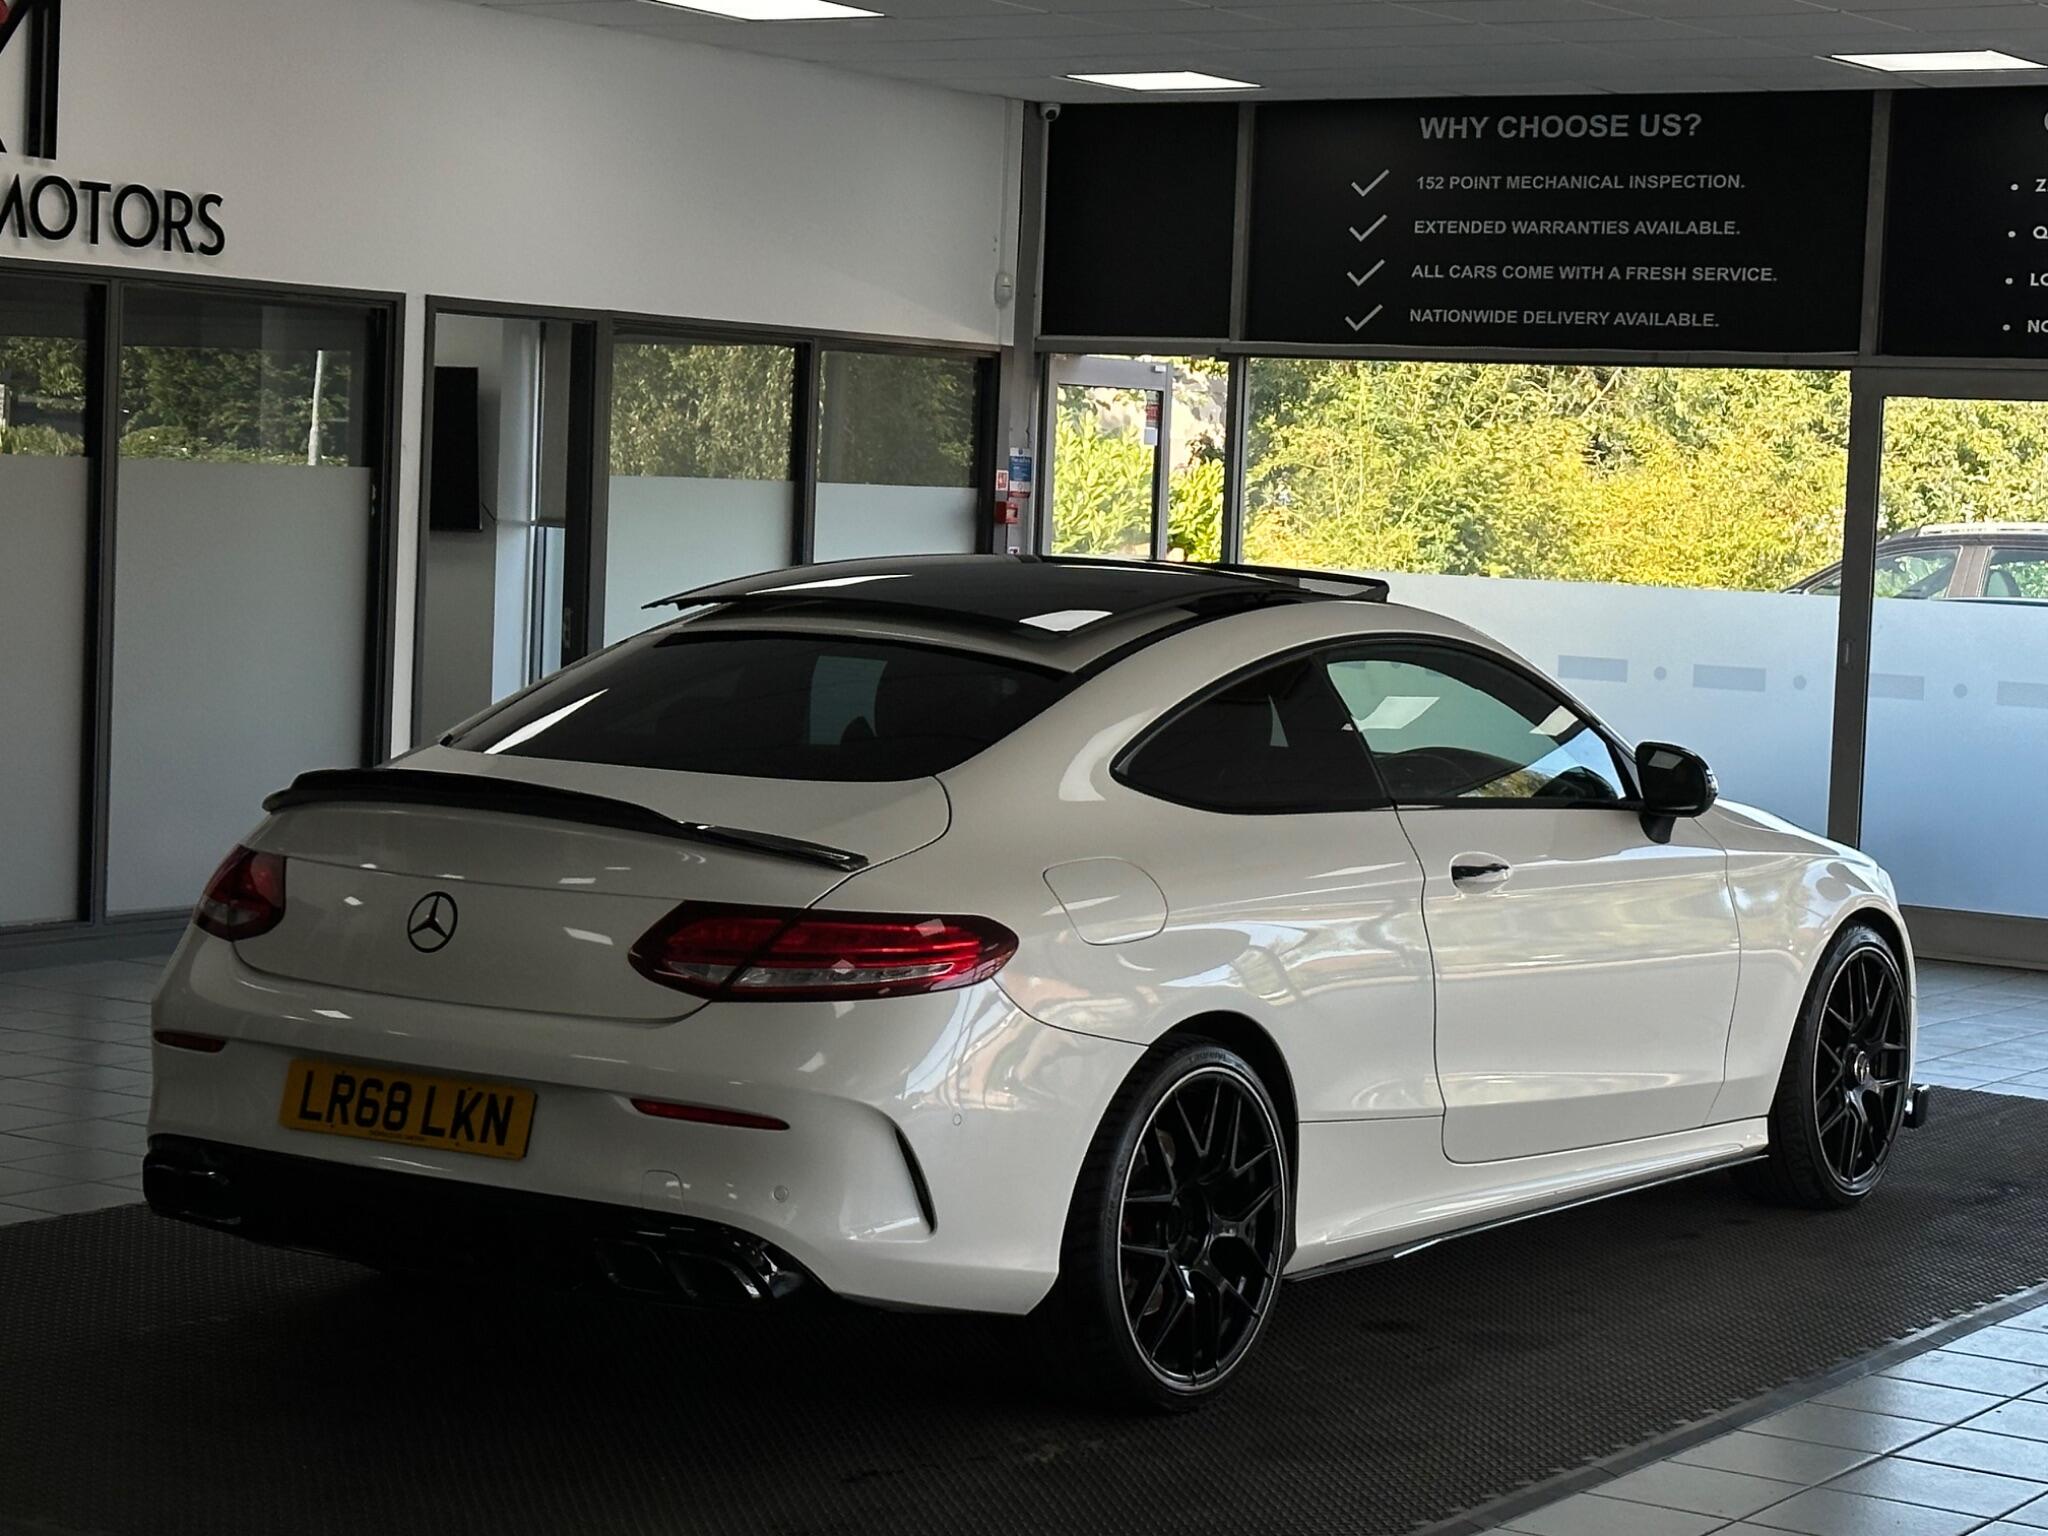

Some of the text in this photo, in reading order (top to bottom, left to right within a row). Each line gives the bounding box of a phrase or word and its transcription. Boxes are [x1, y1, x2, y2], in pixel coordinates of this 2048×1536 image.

[1420, 113, 1702, 139] WHY CHOOSE US?
[1416, 174, 1745, 190] 152 POINT MECHANICAL INSPECTION.
[1414, 220, 1740, 235] EXTENDED WARRANTIES AVAILABLE.
[1411, 264, 1777, 282] ALL CARS COME WITH A FRESH SERVICE.
[1409, 308, 1719, 327] NATIONWIDE DELIVERY AVAILABLE.
[298, 1070, 515, 1147] LR68 LKN
